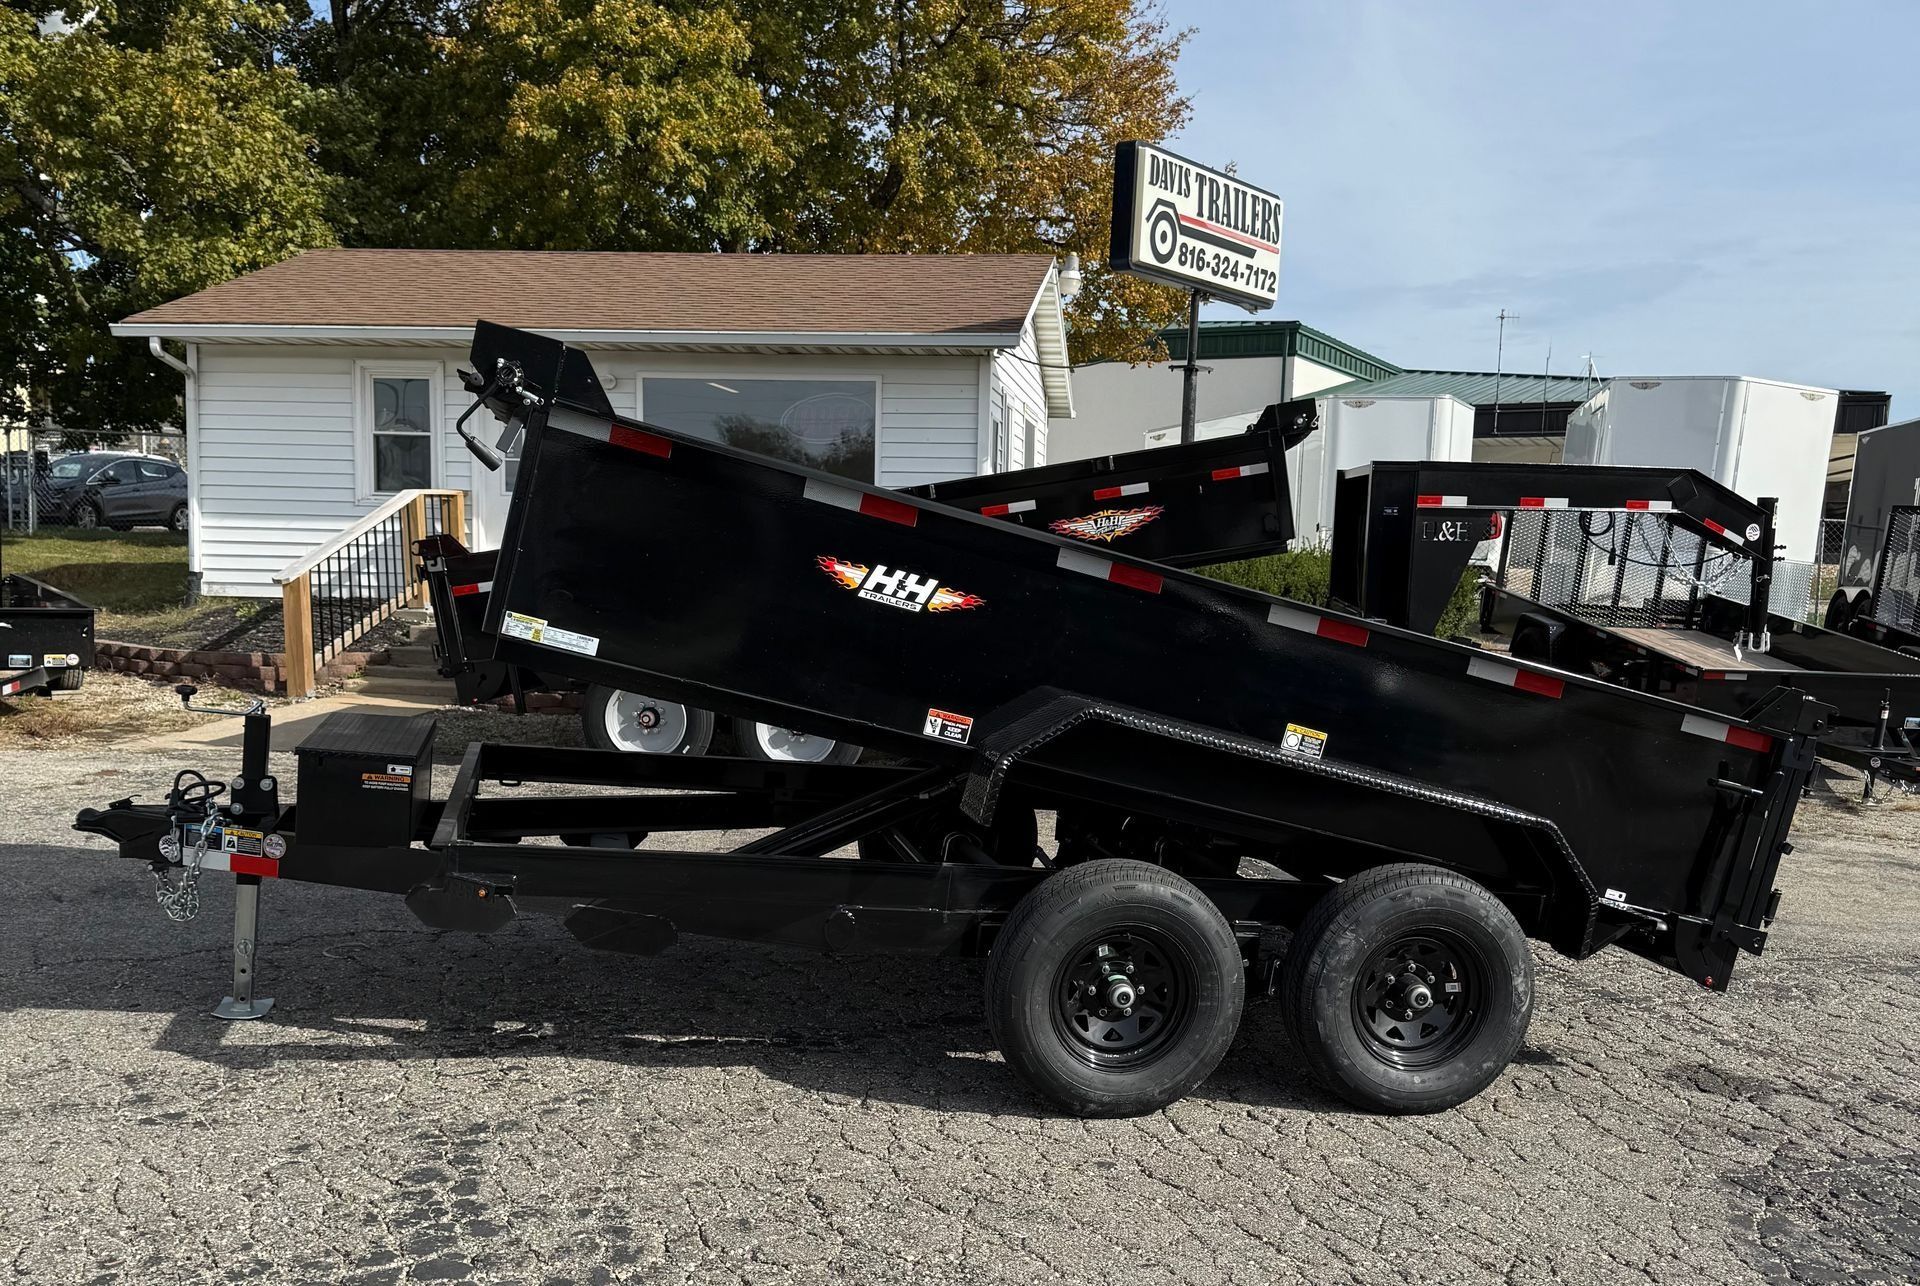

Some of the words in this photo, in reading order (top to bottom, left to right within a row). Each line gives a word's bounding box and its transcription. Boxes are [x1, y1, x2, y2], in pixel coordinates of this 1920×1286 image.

[1149, 154, 1191, 198] DAVIS
[1195, 172, 1281, 245] TRAILERS
[1178, 242, 1277, 293] 816-324-7172
[863, 564, 939, 604] H&H
[863, 591, 918, 611] TRAILERS
[944, 731, 962, 739] CLEAR
